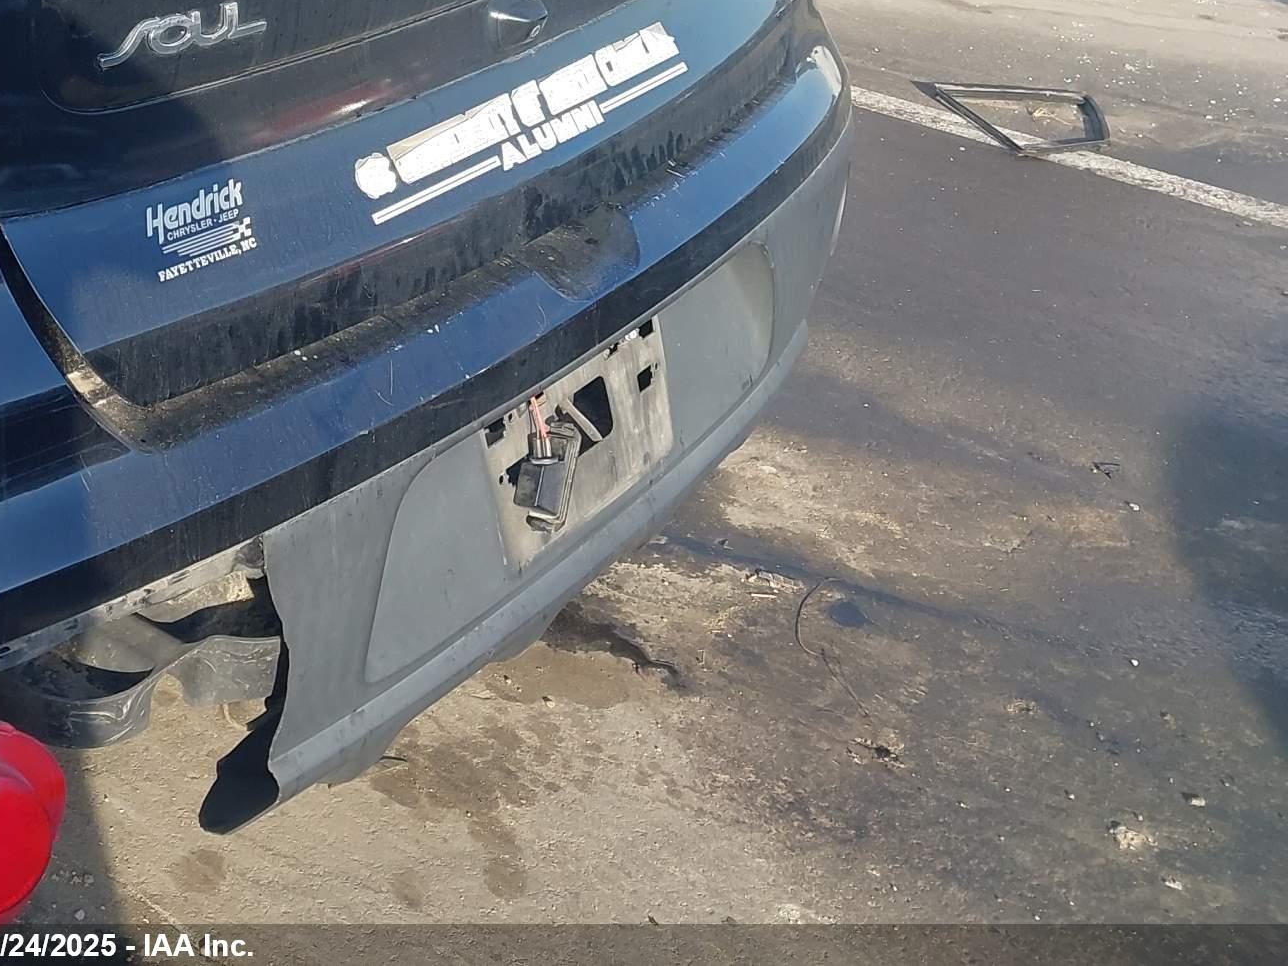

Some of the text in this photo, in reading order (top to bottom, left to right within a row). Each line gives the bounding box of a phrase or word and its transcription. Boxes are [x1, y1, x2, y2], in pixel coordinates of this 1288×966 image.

[97, 1, 268, 70] SOUL
[500, 99, 606, 171] ALUMNI
[146, 178, 243, 245] Hendrick
[166, 208, 239, 241] CHRYSLER JEEP
[157, 237, 258, 282] FAYETTEVILLE, NC
